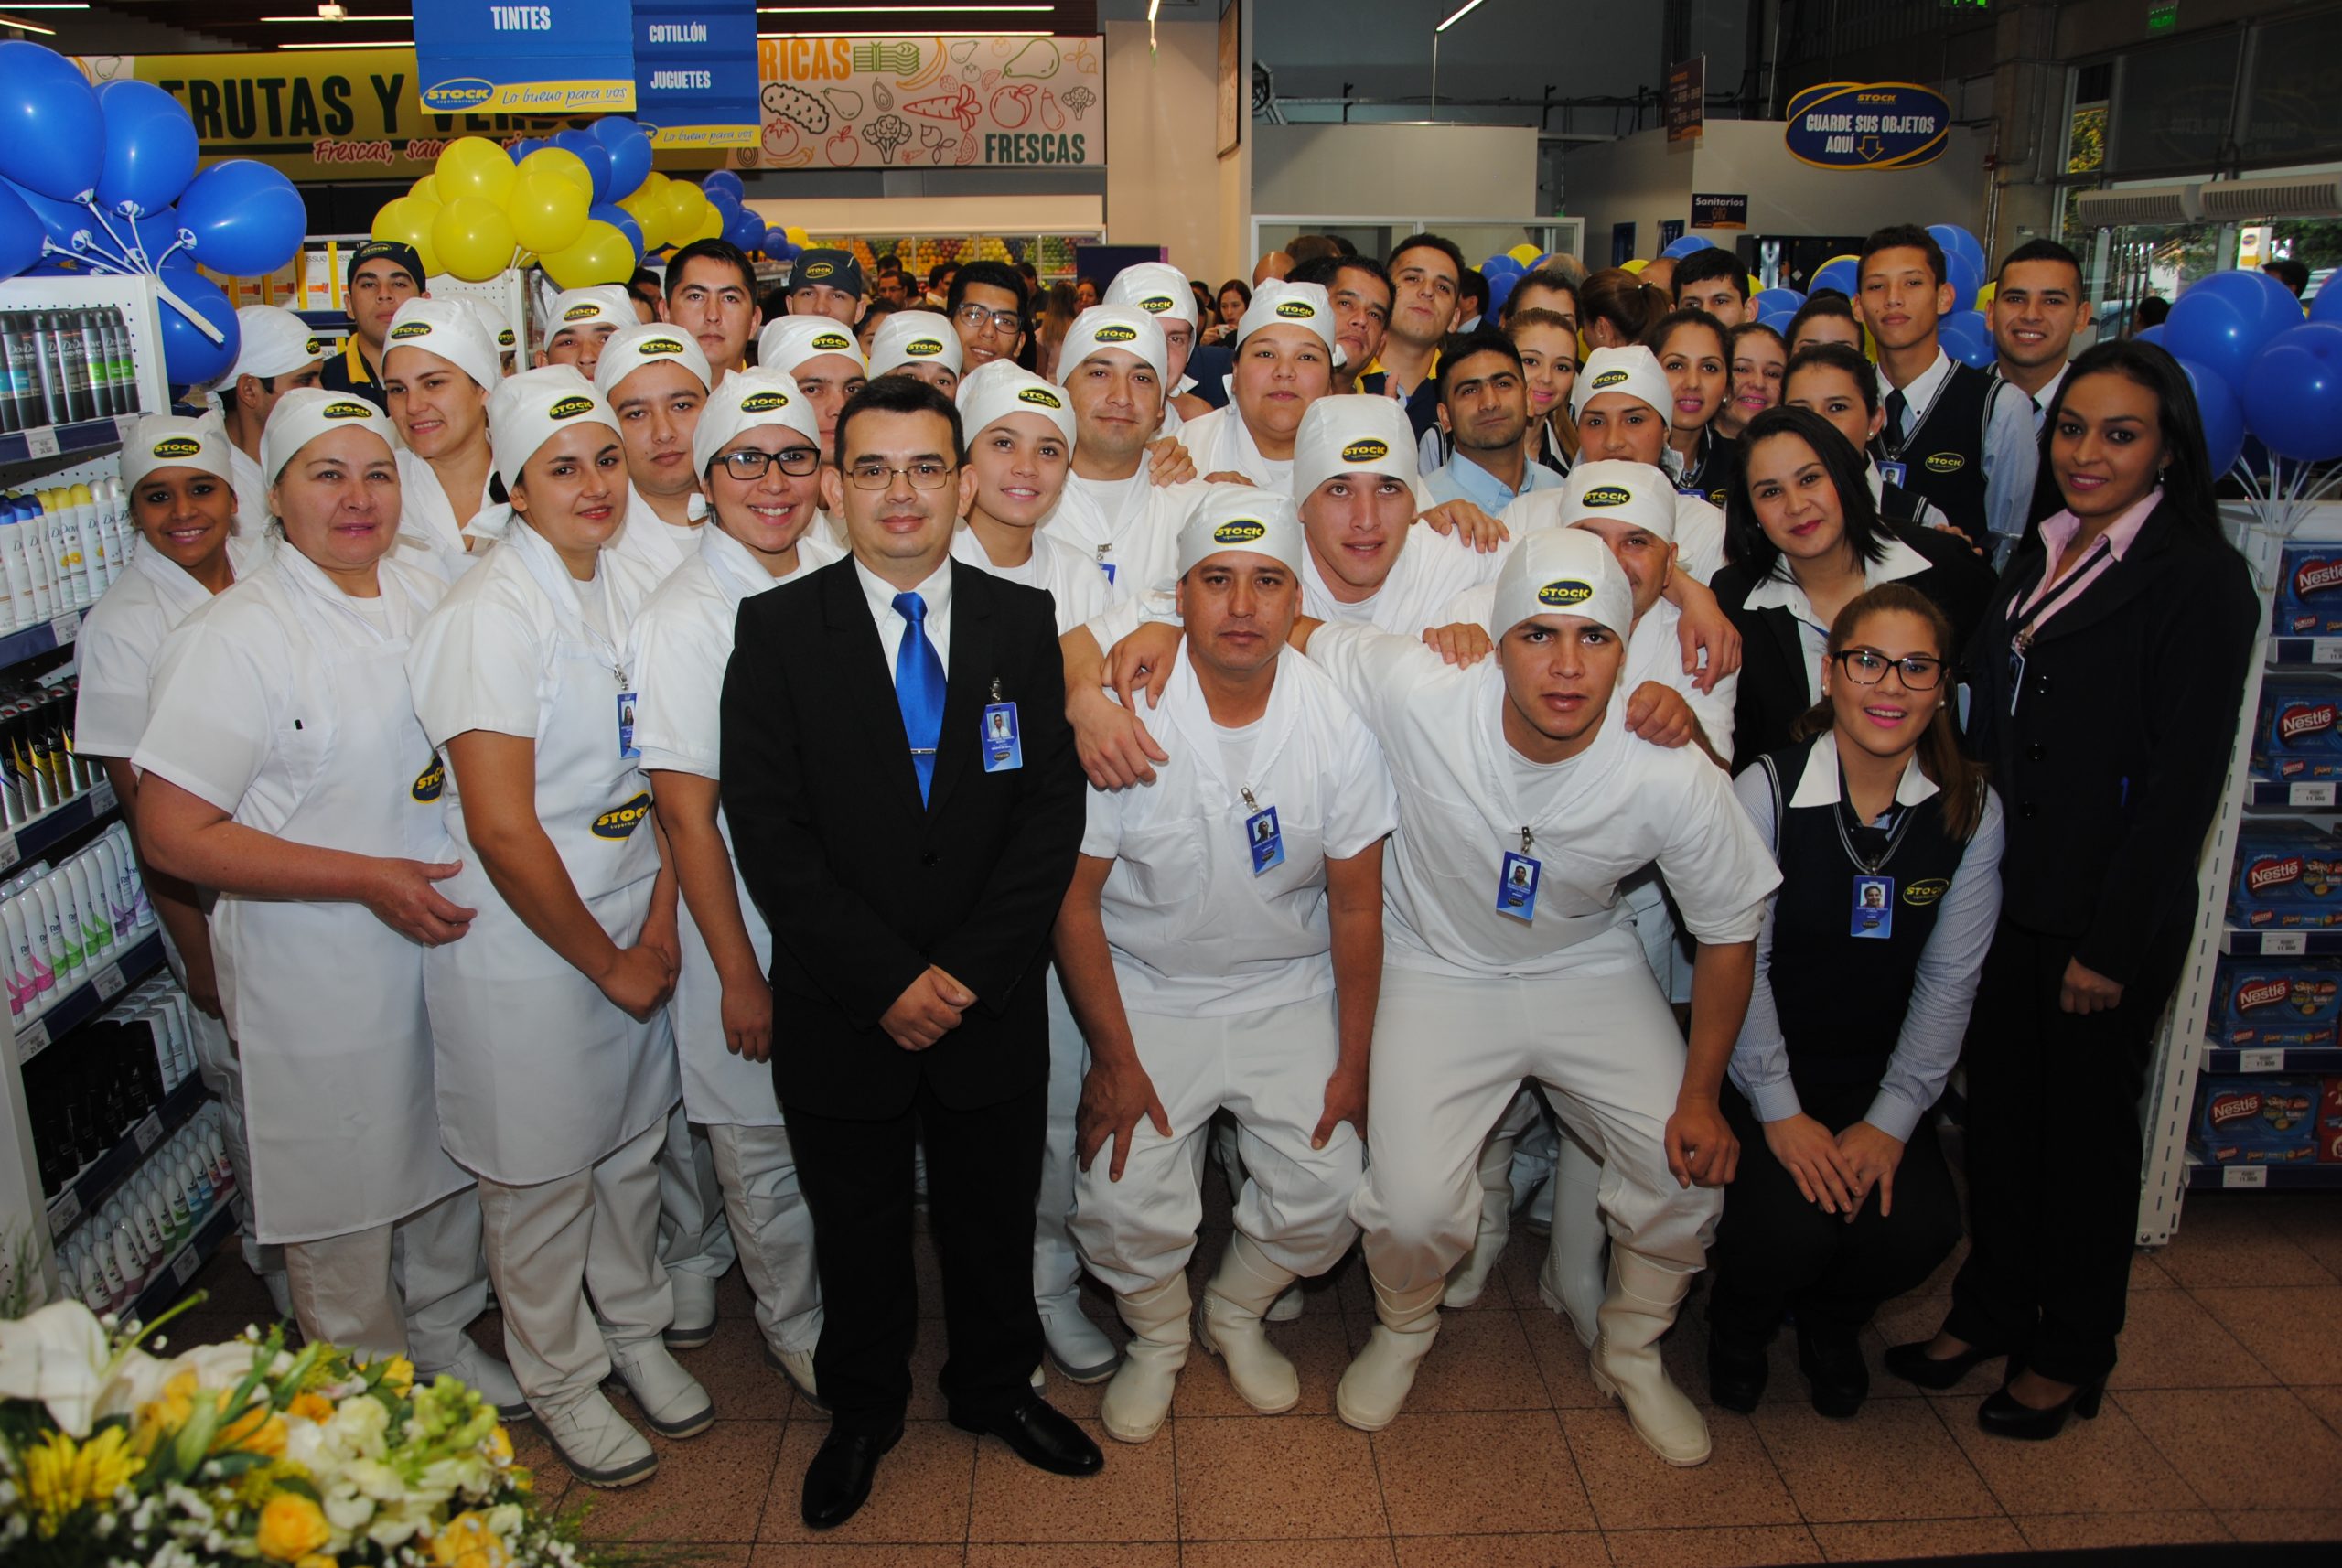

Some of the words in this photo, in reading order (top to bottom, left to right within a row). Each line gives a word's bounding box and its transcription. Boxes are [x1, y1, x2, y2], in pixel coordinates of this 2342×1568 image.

[490, 6, 551, 30] TINTES
[649, 22, 707, 42] COTILLÓN
[758, 38, 851, 81] RICAS
[650, 71, 711, 89] JUGUETES
[426, 89, 490, 101] STOCK
[502, 91, 518, 104] Lo
[522, 88, 563, 103] bueno
[565, 88, 600, 109] para
[606, 86, 627, 99] vos
[1857, 93, 1896, 102] STOCK
[370, 74, 405, 134] Y
[1806, 114, 1853, 132] GUARDE
[1855, 116, 1878, 132] SUS
[1882, 116, 1935, 134] OBJETOS
[663, 133, 675, 142] Lo
[679, 131, 705, 141] bueno
[710, 131, 734, 145] para
[737, 130, 753, 139] vos
[1825, 133, 1854, 153] AQUÍ
[313, 139, 396, 165] Frescas,
[985, 134, 1086, 164] FRESCAS
[1695, 196, 1745, 207] Sanitarios
[807, 265, 832, 274] STOCK
[564, 307, 598, 318] STOCK
[1278, 306, 1314, 317] STOCK
[392, 327, 430, 336] STOCK
[1096, 330, 1134, 340] STOCK
[641, 344, 682, 353] STOCK
[812, 338, 849, 348] STOCK
[908, 343, 941, 352] STOCK
[1592, 373, 1628, 385] STOCK
[742, 397, 788, 409] STOCK
[1020, 391, 1060, 408] STOCK
[326, 405, 371, 417] STOCK
[550, 401, 592, 415] STOCK
[154, 443, 198, 454] STOCK
[1343, 446, 1386, 456] STOCK
[1928, 456, 1961, 467] STOCK
[1584, 491, 1628, 502] STOCK
[1216, 527, 1263, 537] STOCK
[1540, 586, 1590, 598] STOCK
[2283, 708, 2332, 732] Nestlé
[2251, 861, 2299, 884] Nestlé
[2240, 982, 2286, 1004] Nestlé
[2213, 1096, 2258, 1118] Nestlé
